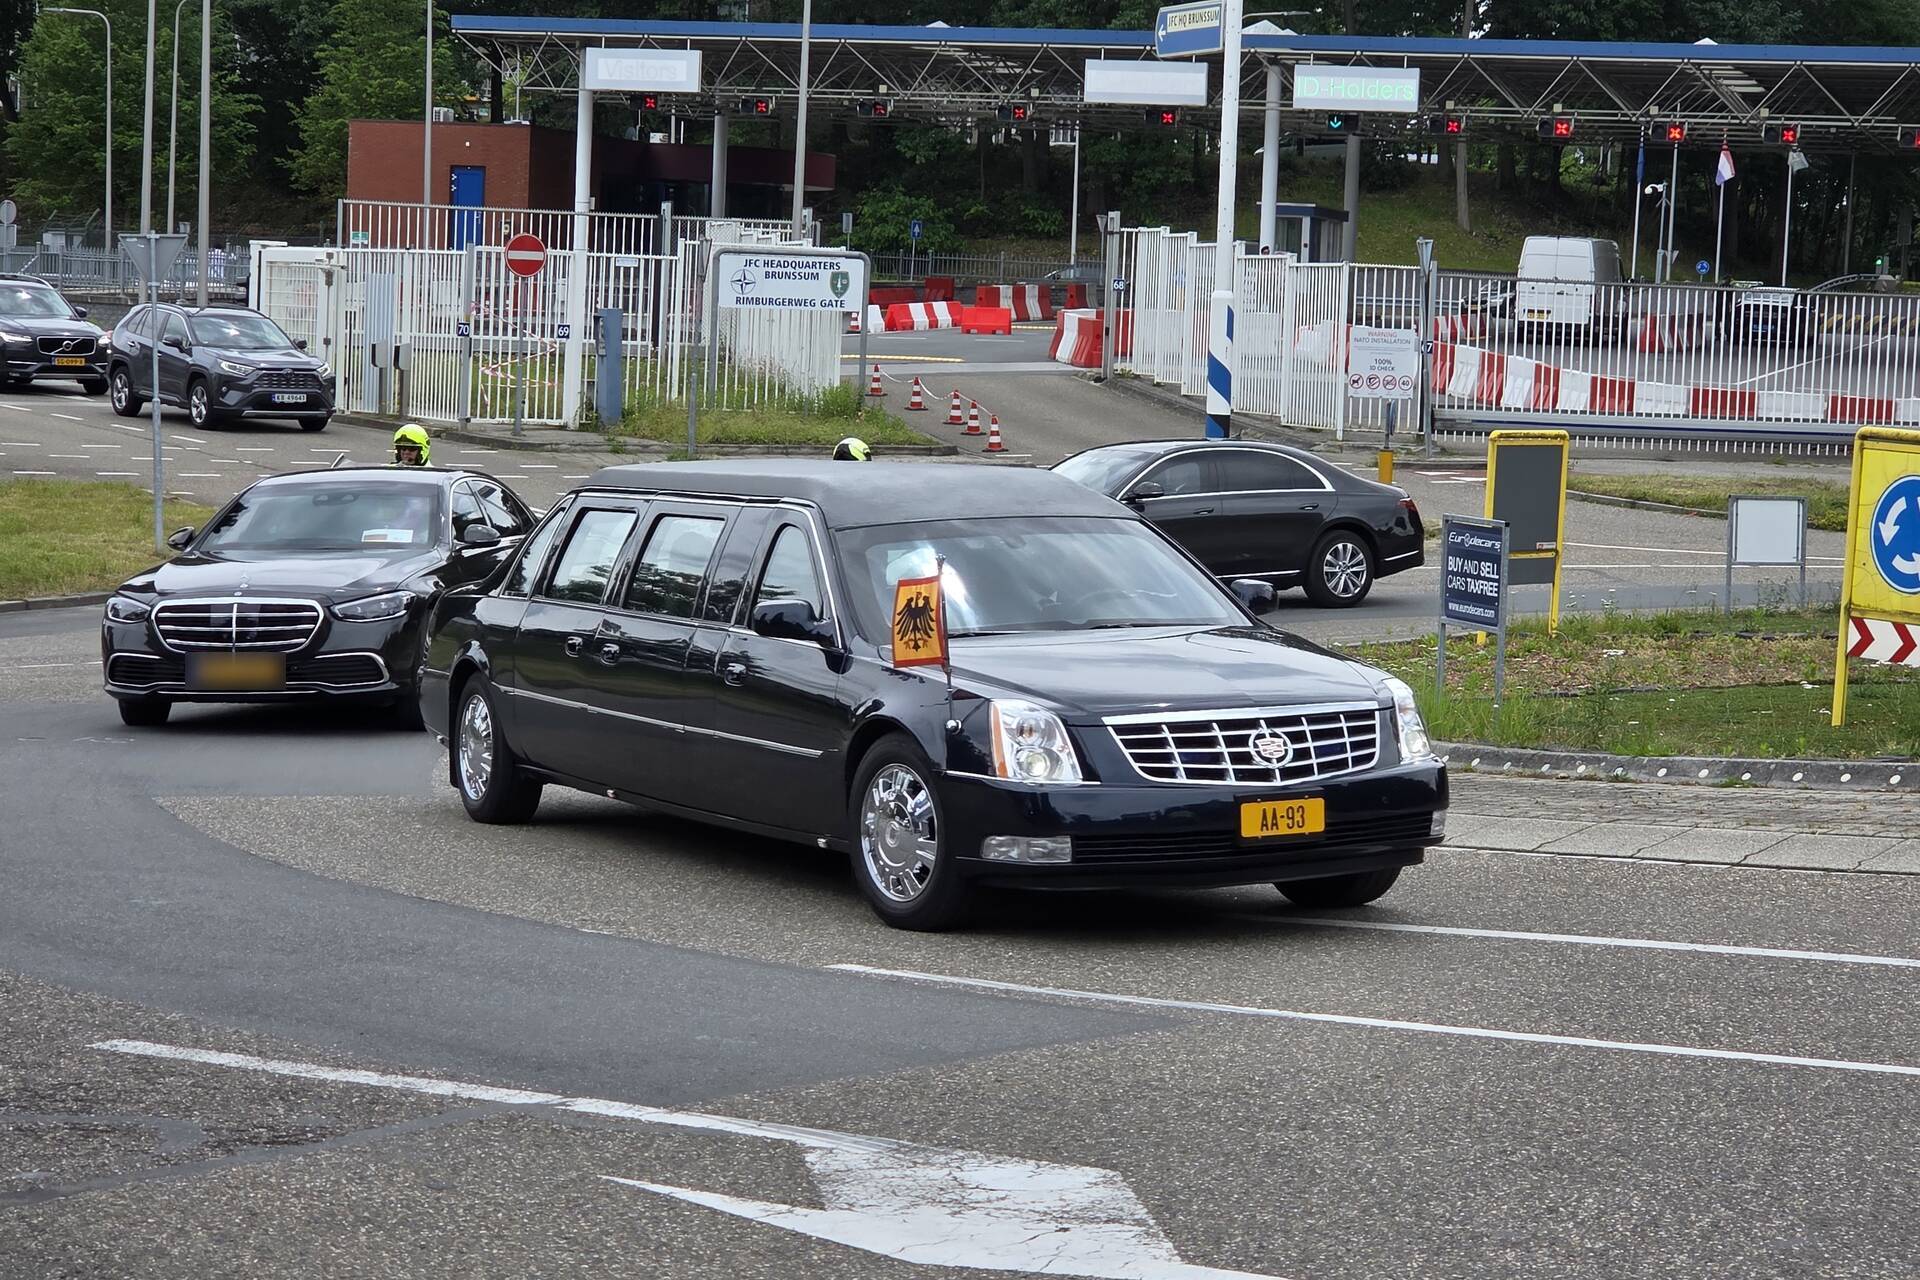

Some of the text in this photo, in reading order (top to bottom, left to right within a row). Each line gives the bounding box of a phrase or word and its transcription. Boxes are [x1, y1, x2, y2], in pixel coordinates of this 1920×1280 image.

[1179, 14, 1187, 28] HQ
[604, 59, 677, 80] Visitors
[1296, 76, 1414, 101] ID-Holders
[743, 259, 841, 270] JFC HEADQUARTERS
[764, 271, 820, 280] BRUNSSUM
[1113, 280, 1124, 290] 68
[735, 296, 846, 308] RIMBURGERWEG GATE
[458, 324, 470, 335] 70
[558, 326, 569, 337] 69
[1374, 358, 1393, 366] 100%
[1448, 556, 1499, 579] BUY AND SELL
[1447, 574, 1498, 597] CARS TAXFREE
[1448, 602, 1495, 618] www.eurodecars.com
[1260, 805, 1305, 832] AA-93
